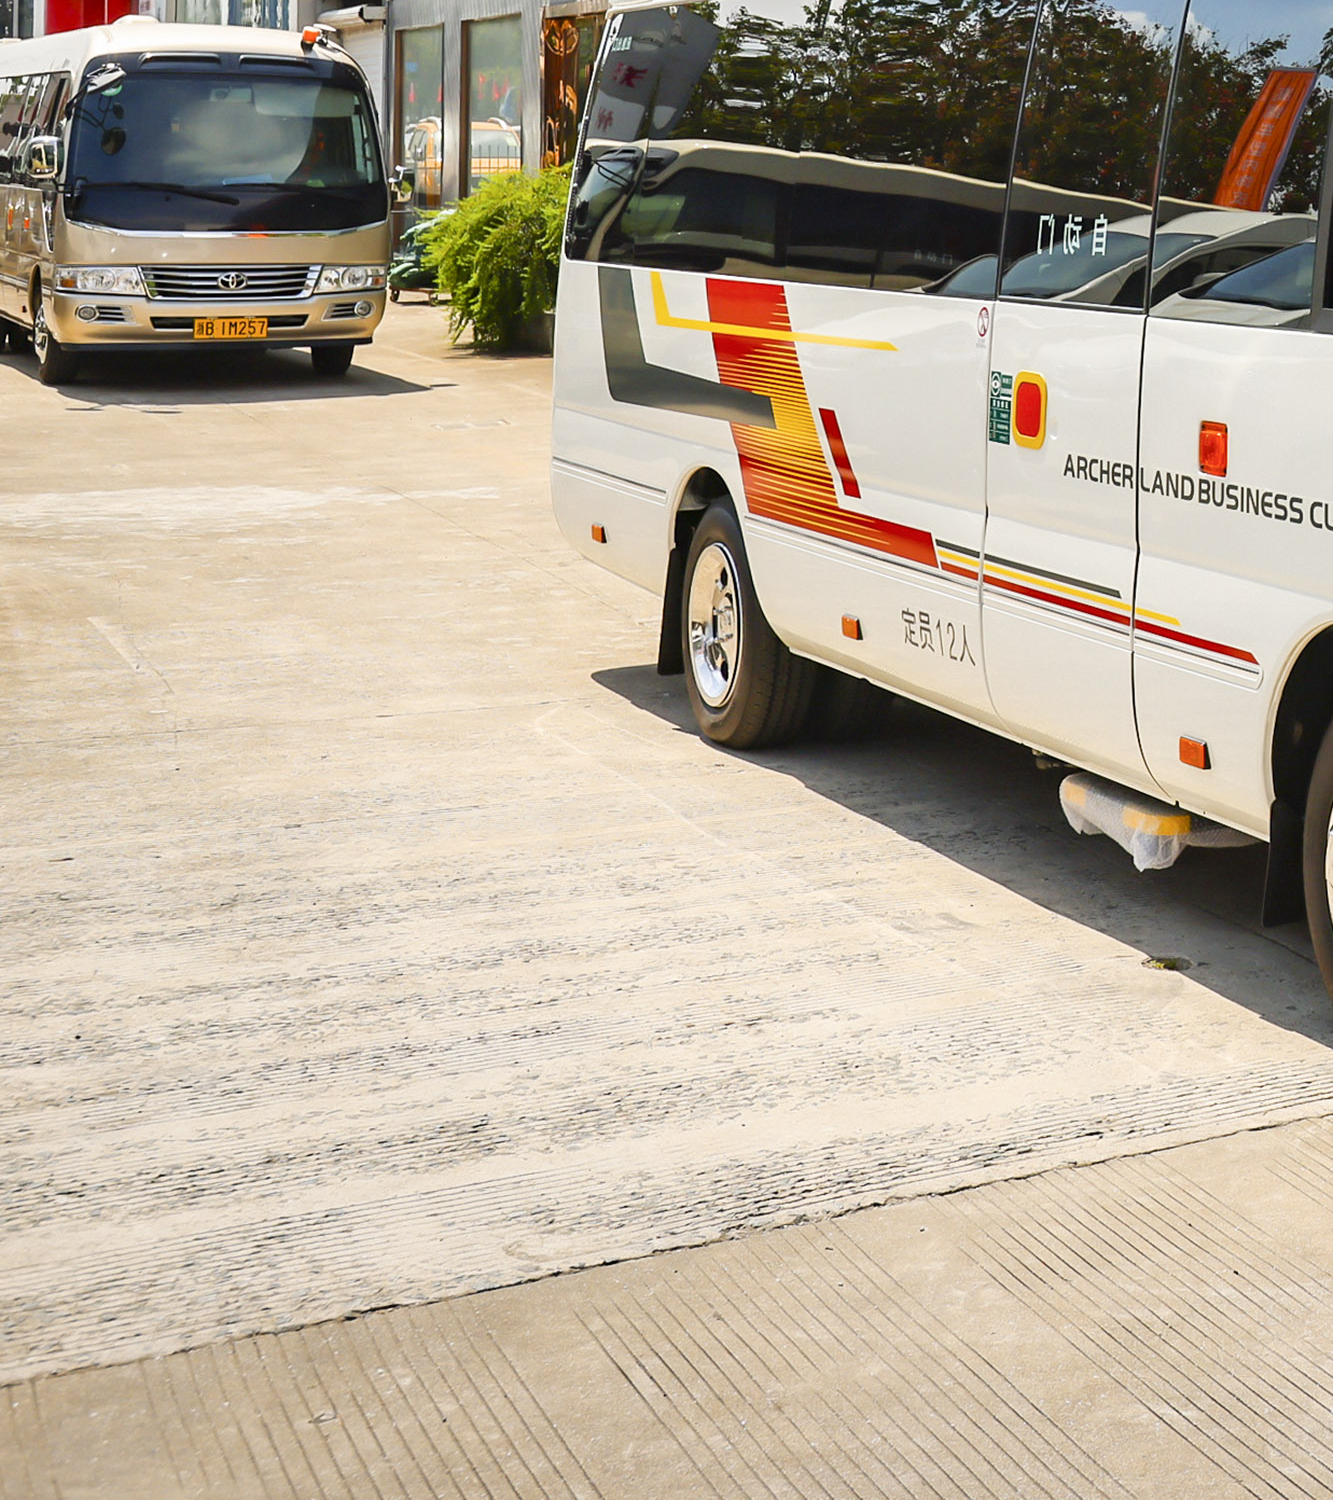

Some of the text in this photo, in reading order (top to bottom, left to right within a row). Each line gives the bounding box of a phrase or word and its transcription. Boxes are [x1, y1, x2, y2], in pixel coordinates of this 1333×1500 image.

[1063, 454, 1134, 489] ARCHER
[1140, 467, 1195, 501] LAND
[1198, 478, 1303, 524] BUSINESS
[901, 608, 976, 666] 定员12人
